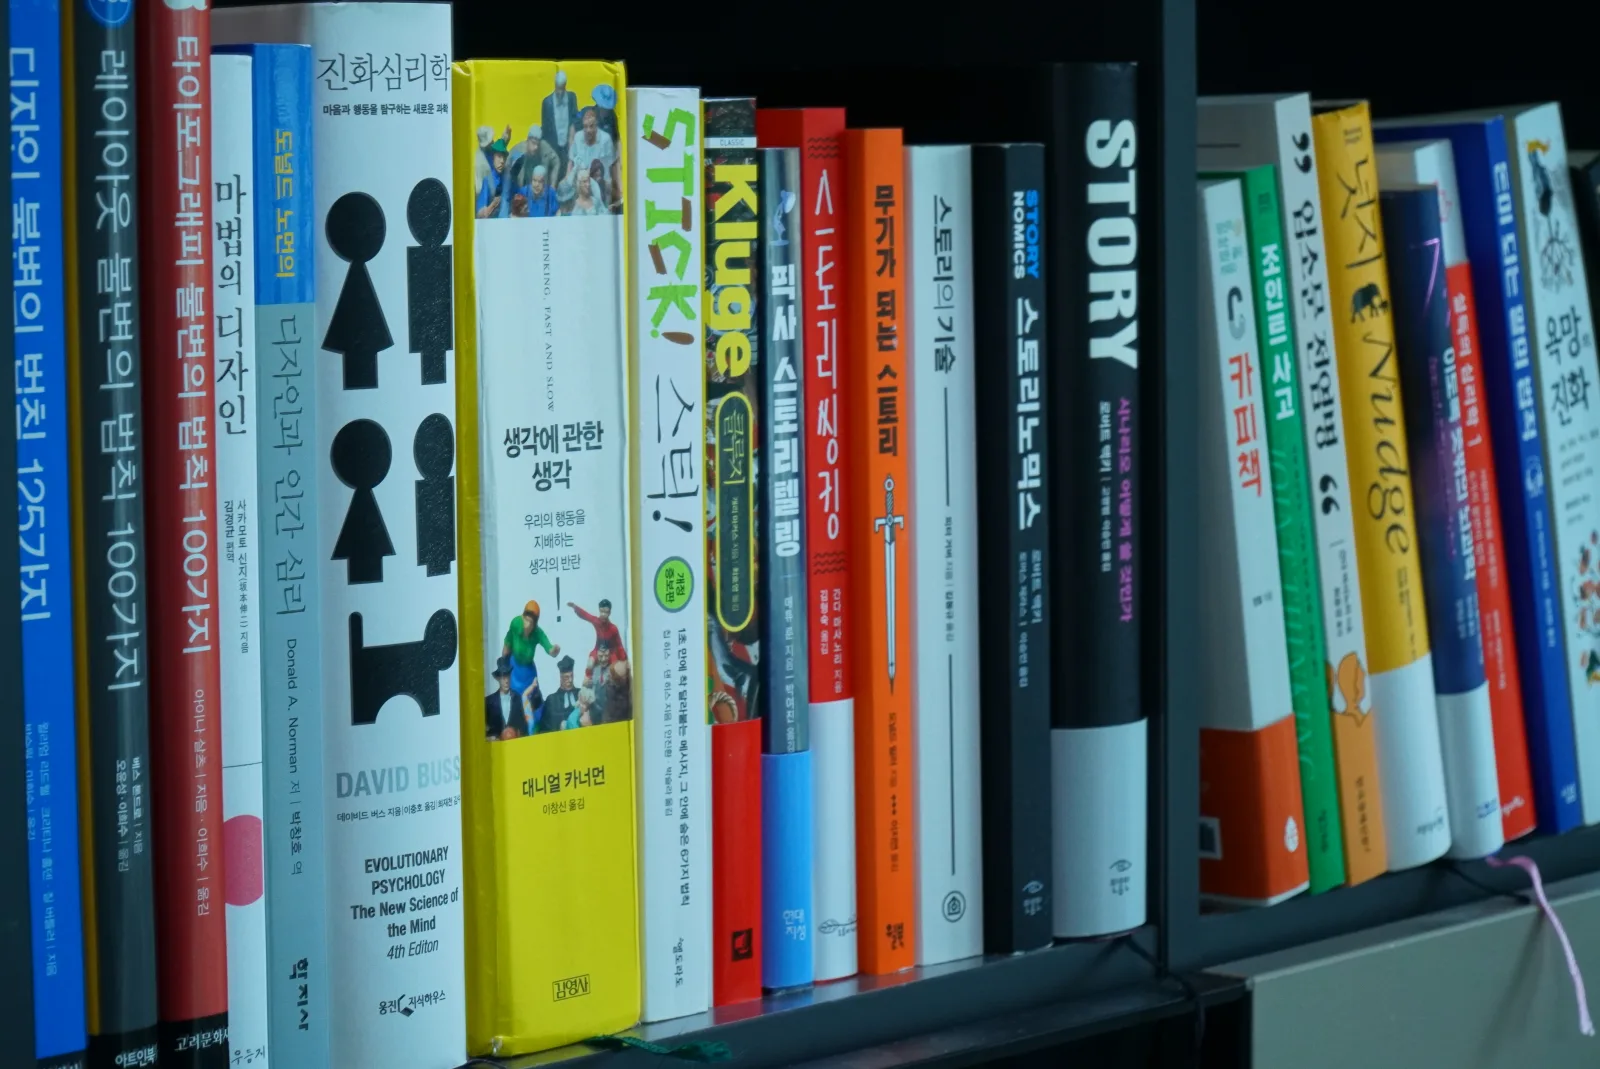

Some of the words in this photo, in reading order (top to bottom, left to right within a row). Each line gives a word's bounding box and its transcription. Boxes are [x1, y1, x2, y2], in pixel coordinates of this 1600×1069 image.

[316, 52, 450, 92] 진화심리학
[322, 104, 350, 116] 마음과
[353, 103, 378, 116] 행동을
[380, 103, 411, 115] 탐구하는
[413, 103, 434, 115] 새로운
[94, 49, 131, 233] 레이아웃
[172, 36, 204, 266] 타이포그래피
[719, 138, 745, 147] CLASSIC
[274, 128, 293, 200] 도널드
[1336, 158, 1383, 270] 넛지
[1493, 161, 1513, 226] 돈이
[215, 173, 247, 295] 마법의
[275, 207, 295, 278] 노먼의
[641, 107, 698, 345] STICK!
[874, 185, 897, 278] 무기가
[1013, 190, 1026, 280] NOMICS
[1026, 189, 1039, 279] STORY
[1085, 119, 1138, 369] STORY
[710, 164, 758, 378] Kluge
[933, 195, 954, 309] 스토리의
[1501, 231, 1519, 298] 되는
[97, 253, 134, 390] 불변의
[543, 305, 553, 337] FAST
[771, 264, 797, 341] 픽사
[876, 290, 898, 352] 되는
[176, 282, 207, 398] 불변의
[544, 342, 554, 371] AND
[934, 315, 956, 375] 기술
[216, 306, 249, 435] 디자인
[271, 314, 304, 456] 디자인과
[1272, 351, 1295, 421] 사고
[546, 376, 555, 412] SLOW
[877, 364, 899, 456] 스토리
[1017, 297, 1041, 530] 스토리노믹스
[1459, 364, 1479, 427] 심리학
[1551, 366, 1591, 426] 진화
[503, 423, 559, 458] 생각에
[562, 420, 604, 453] 관한
[1118, 398, 1132, 474] 시나리오
[1228, 351, 1262, 498] 카피책
[1361, 332, 1410, 555] Nudge
[101, 413, 137, 501] 법칙
[178, 415, 209, 489] 법칙
[647, 374, 699, 532] 스틱!
[722, 409, 745, 485] 클루지
[772, 356, 800, 557] 스토리텔링
[532, 459, 572, 492] 생각
[224, 500, 235, 538] 김경균
[237, 499, 247, 548] 사카모토
[274, 468, 305, 540] 인간
[524, 511, 553, 530] 우리의
[555, 508, 586, 527] 행동을
[17, 458, 51, 621] 125가지
[534, 532, 574, 550] 지배하는
[181, 509, 211, 654] 100가지
[275, 549, 306, 616] 심리
[529, 557, 559, 575] 생각의
[561, 554, 581, 571] 반란
[665, 567, 674, 604] 증보판
[676, 573, 685, 597] 개정
[106, 521, 141, 691] 100가지
[240, 632, 249, 653] 지음
[663, 642, 673, 660] 히스
[677, 628, 687, 645] 1초
[287, 638, 298, 690] Donald
[677, 648, 688, 672] 만에
[677, 675, 688, 687] 착
[193, 688, 206, 733] 아이나
[287, 695, 299, 711] A.
[663, 682, 673, 701] 히스
[663, 703, 673, 722] 지음
[678, 690, 689, 737] 달라붙는
[194, 738, 207, 769] 살츠
[288, 717, 300, 774] Norman
[663, 729, 673, 758] 안진환
[195, 784, 208, 814] 지음
[289, 780, 301, 794] 저
[336, 765, 409, 799] DAVID
[417, 755, 460, 789] BUSS
[522, 772, 560, 798] 대니얼
[564, 765, 605, 790] 카너먼
[679, 781, 689, 794] 그
[336, 811, 369, 822] 데이비드
[370, 809, 386, 819] 버스
[542, 800, 567, 816] 이창신
[568, 797, 585, 812] 옮김
[664, 797, 674, 817] 옮김
[679, 797, 689, 820] 안에
[196, 827, 209, 872] 이희수
[289, 811, 302, 856] 박창호
[679, 822, 690, 847] 숨은
[118, 847, 130, 872] 옮김
[290, 861, 303, 875] 역
[364, 845, 449, 874] EVOLUTIONARY
[371, 868, 446, 895] PSYCHOLOGY
[679, 849, 690, 880] 6가지
[197, 886, 210, 917] 옮김
[350, 903, 376, 920] The
[379, 898, 406, 916] New
[409, 892, 449, 913] Science
[450, 887, 460, 904] of
[680, 883, 691, 906] 법칙
[783, 908, 804, 925] 현대
[387, 922, 407, 938] the
[410, 915, 436, 936] Mind
[785, 925, 806, 941] 지성
[387, 944, 405, 960] 4th
[289, 957, 309, 1031] 학지사
[378, 999, 397, 1016] 웅진
[408, 989, 447, 1010] 지식하우스
[554, 978, 589, 1000] 김영사
[115, 1043, 158, 1068] 아트인북
